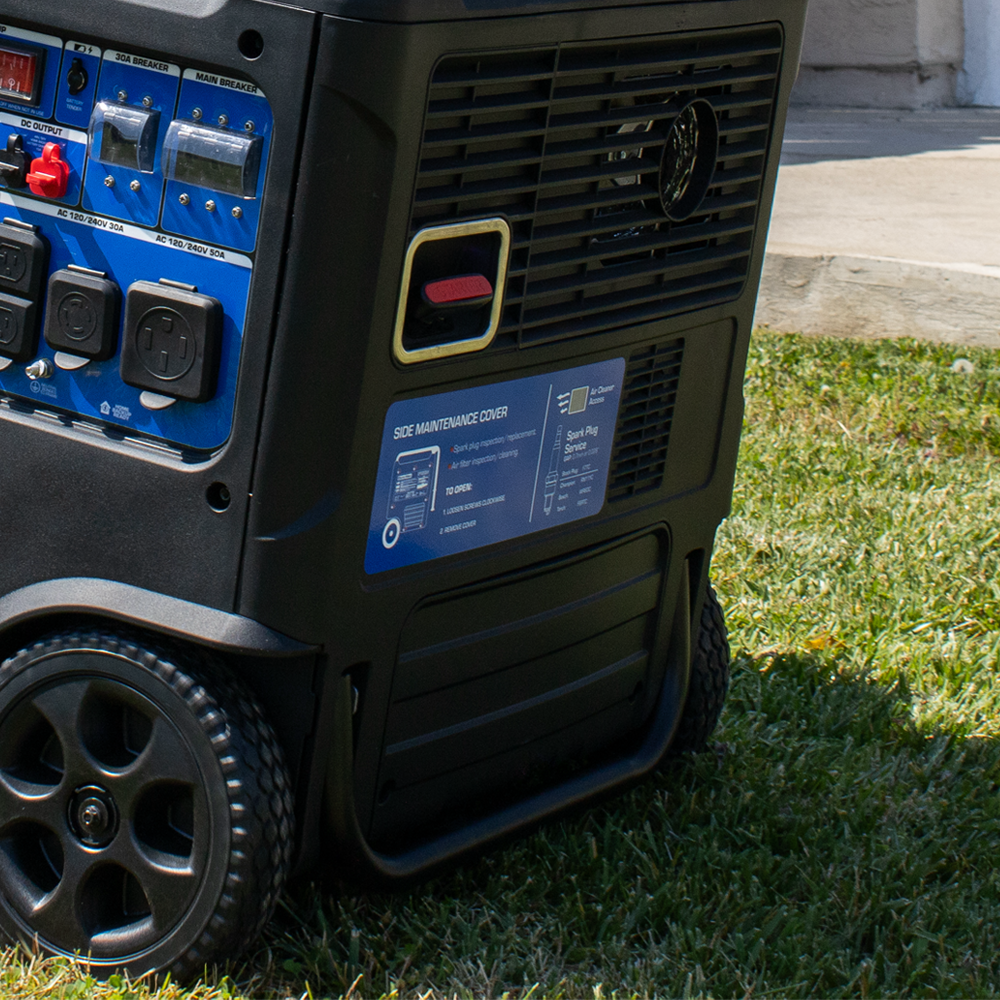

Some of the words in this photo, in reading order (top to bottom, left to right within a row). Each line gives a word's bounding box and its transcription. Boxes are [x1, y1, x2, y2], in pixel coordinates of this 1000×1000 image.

[115, 53, 131, 63] 30A
[133, 56, 169, 72] BREAKER
[195, 72, 218, 85] MAIN
[219, 78, 258, 94] BREAKER
[21, 119, 32, 128] DC
[33, 121, 63, 136] OUTPUT
[57, 208, 68, 217] AC
[69, 211, 108, 229] 120/240V
[108, 222, 124, 232] 30A
[155, 235, 167, 243] AC
[168, 238, 207, 255] 120/240V
[209, 249, 225, 259] 50A
[393, 424, 414, 440] SIDE
[415, 411, 479, 436] MAINTENANCE
[479, 405, 508, 422] COVER
[566, 427, 585, 442] Spark
[585, 425, 599, 437] Plug
[564, 440, 587, 454] Service
[445, 486, 454, 496] TO
[454, 482, 473, 494] OPEN:
[462, 519, 477, 529] COVER
